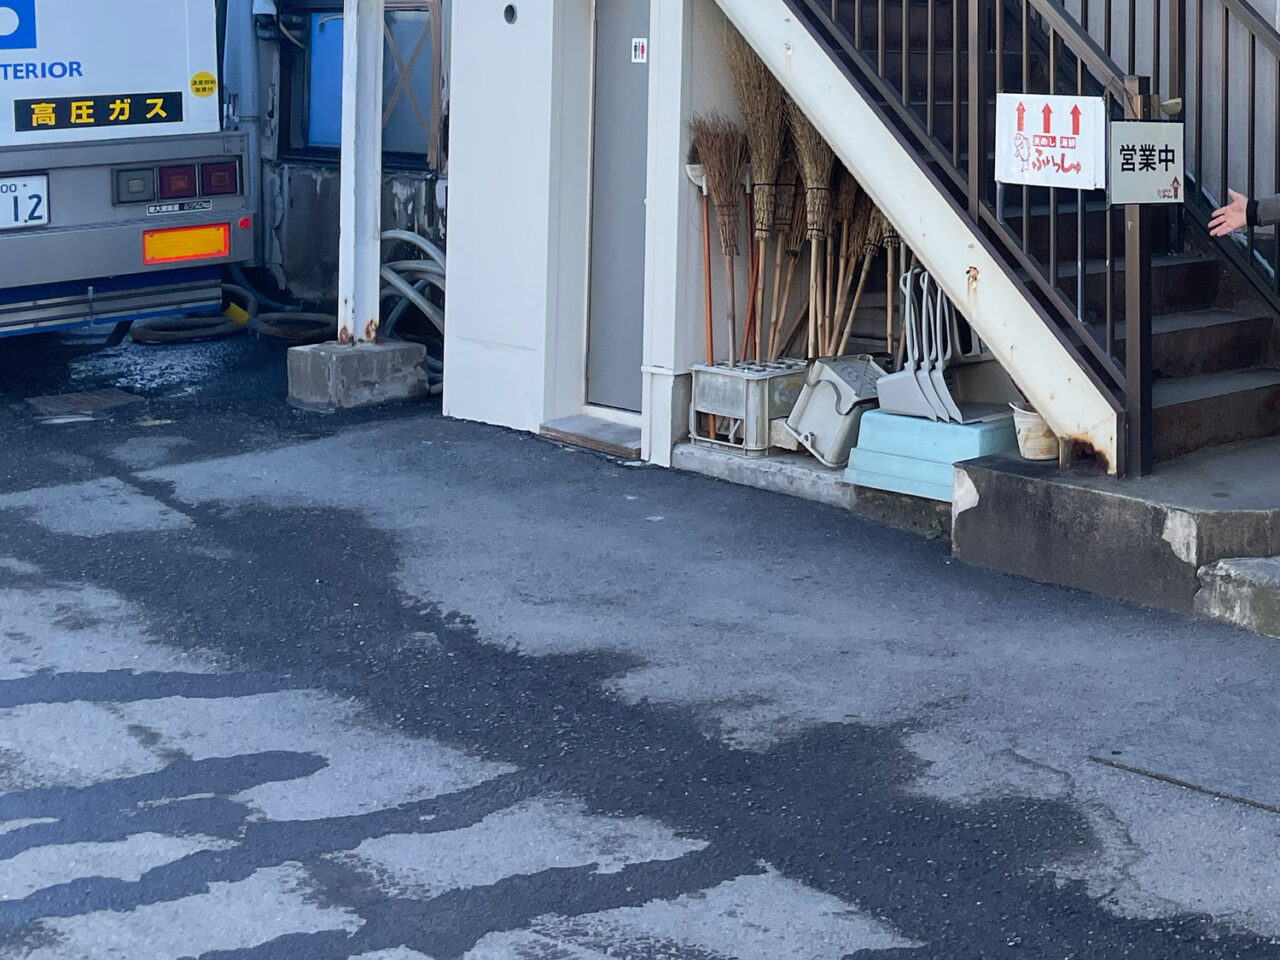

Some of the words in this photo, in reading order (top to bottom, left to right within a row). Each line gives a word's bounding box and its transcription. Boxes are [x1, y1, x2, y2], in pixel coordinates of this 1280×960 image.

[0, 61, 83, 80] TERIOR
[31, 98, 167, 127] 高圧ガス
[1119, 144, 1176, 172] 営業中
